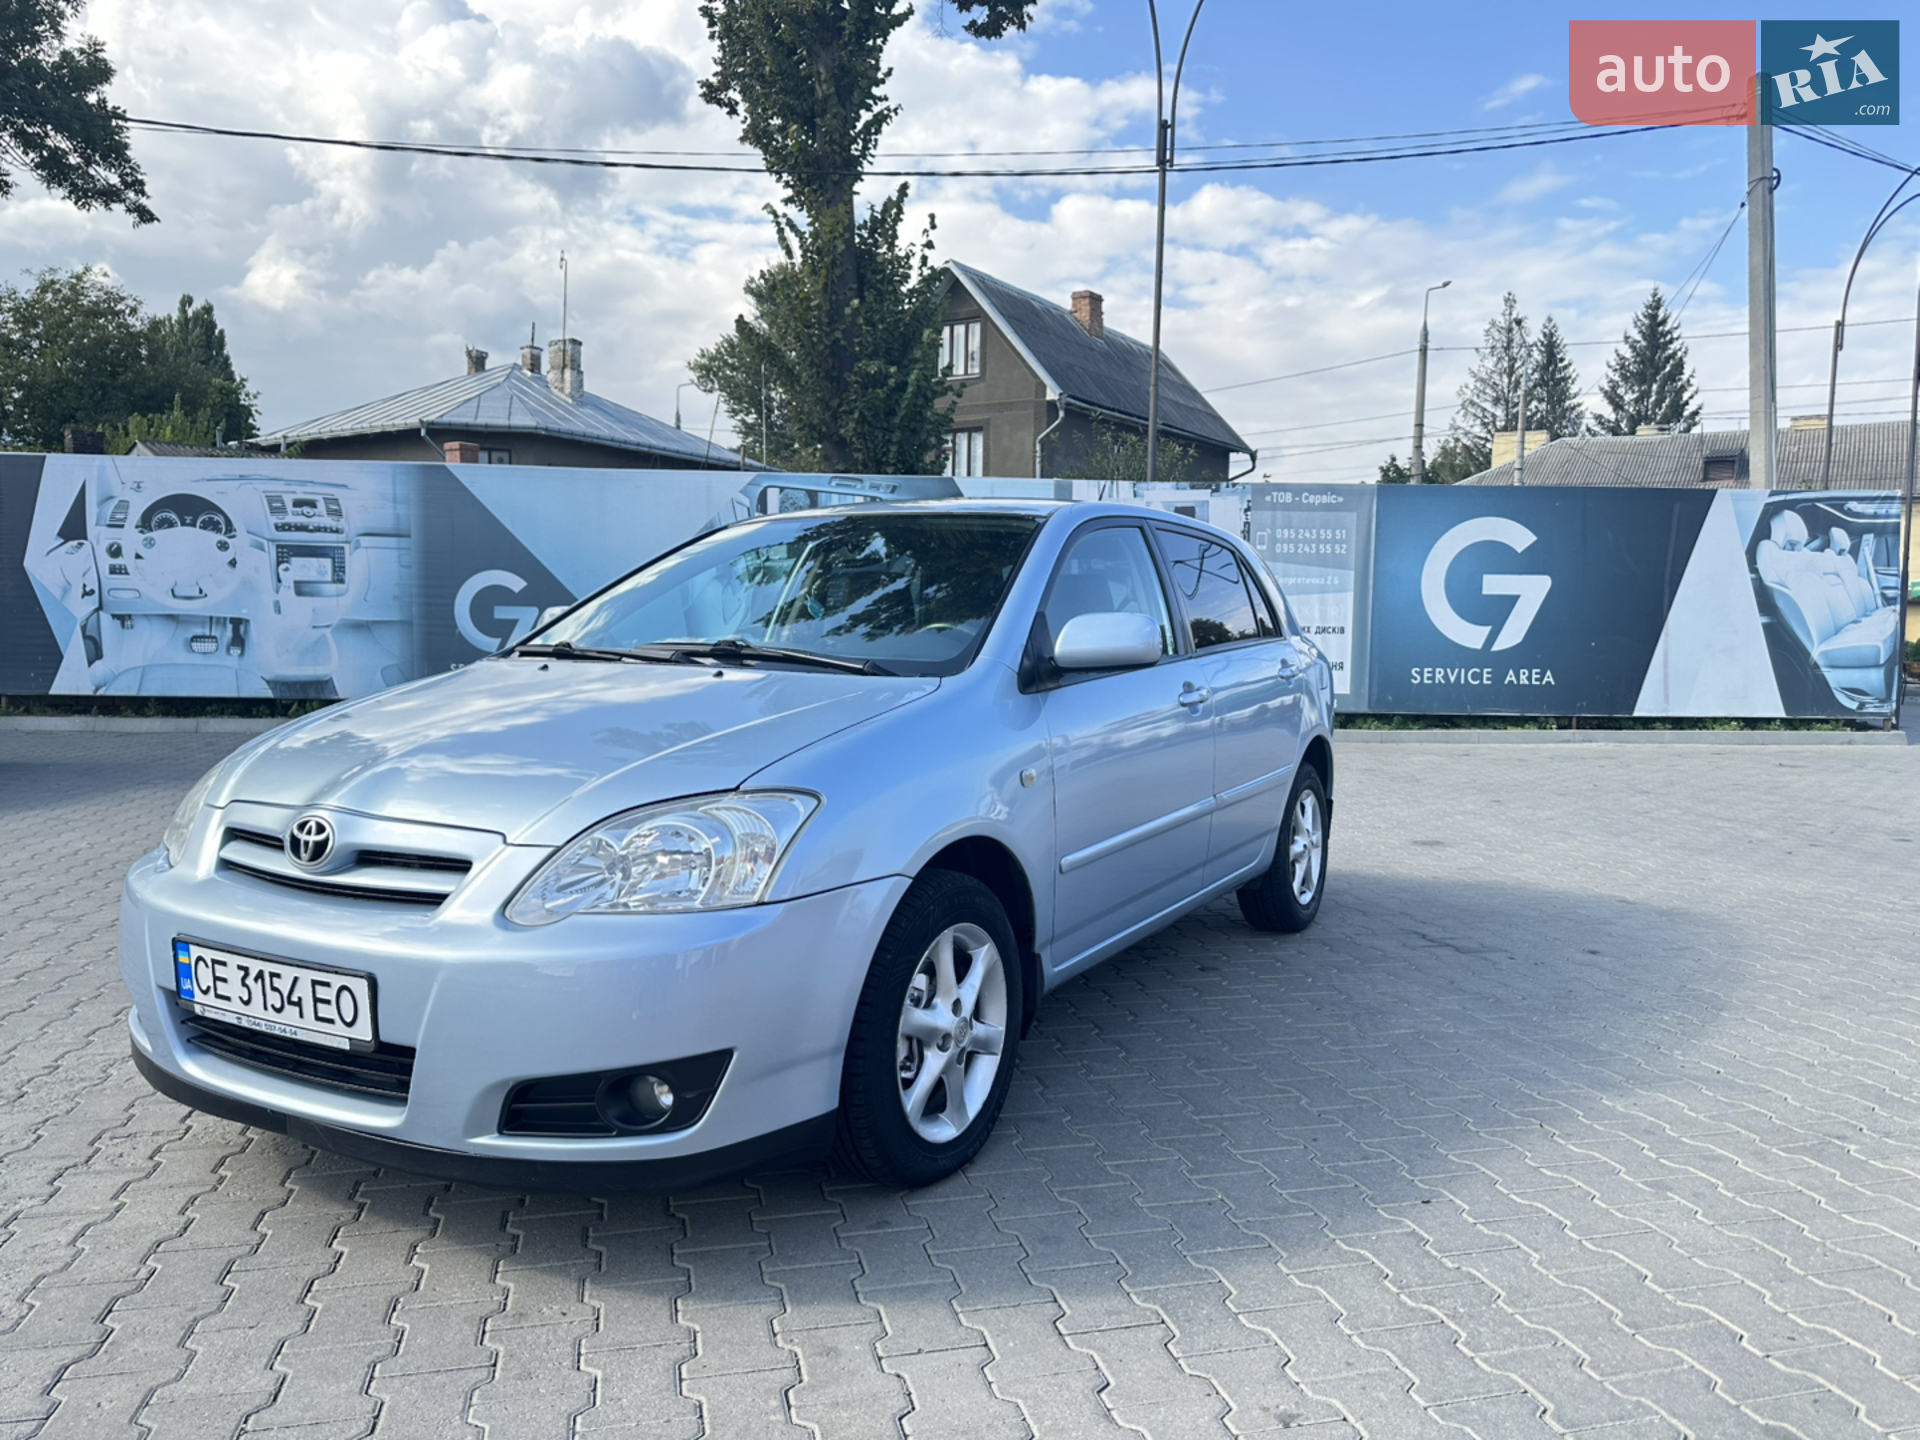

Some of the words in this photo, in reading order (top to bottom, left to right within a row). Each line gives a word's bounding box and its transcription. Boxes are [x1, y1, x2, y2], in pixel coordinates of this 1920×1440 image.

[1275, 528, 1296, 539] 095
[1298, 528, 1317, 539] 243
[1319, 529, 1333, 540] 55
[1335, 529, 1346, 540] 51
[1275, 543, 1295, 553] 095
[1297, 543, 1317, 554] 243
[1319, 543, 1332, 554] 55
[1334, 544, 1348, 554] 52
[1410, 667, 1493, 685] SERVICE
[1504, 668, 1556, 686] AREA
[180, 977, 193, 991] UA
